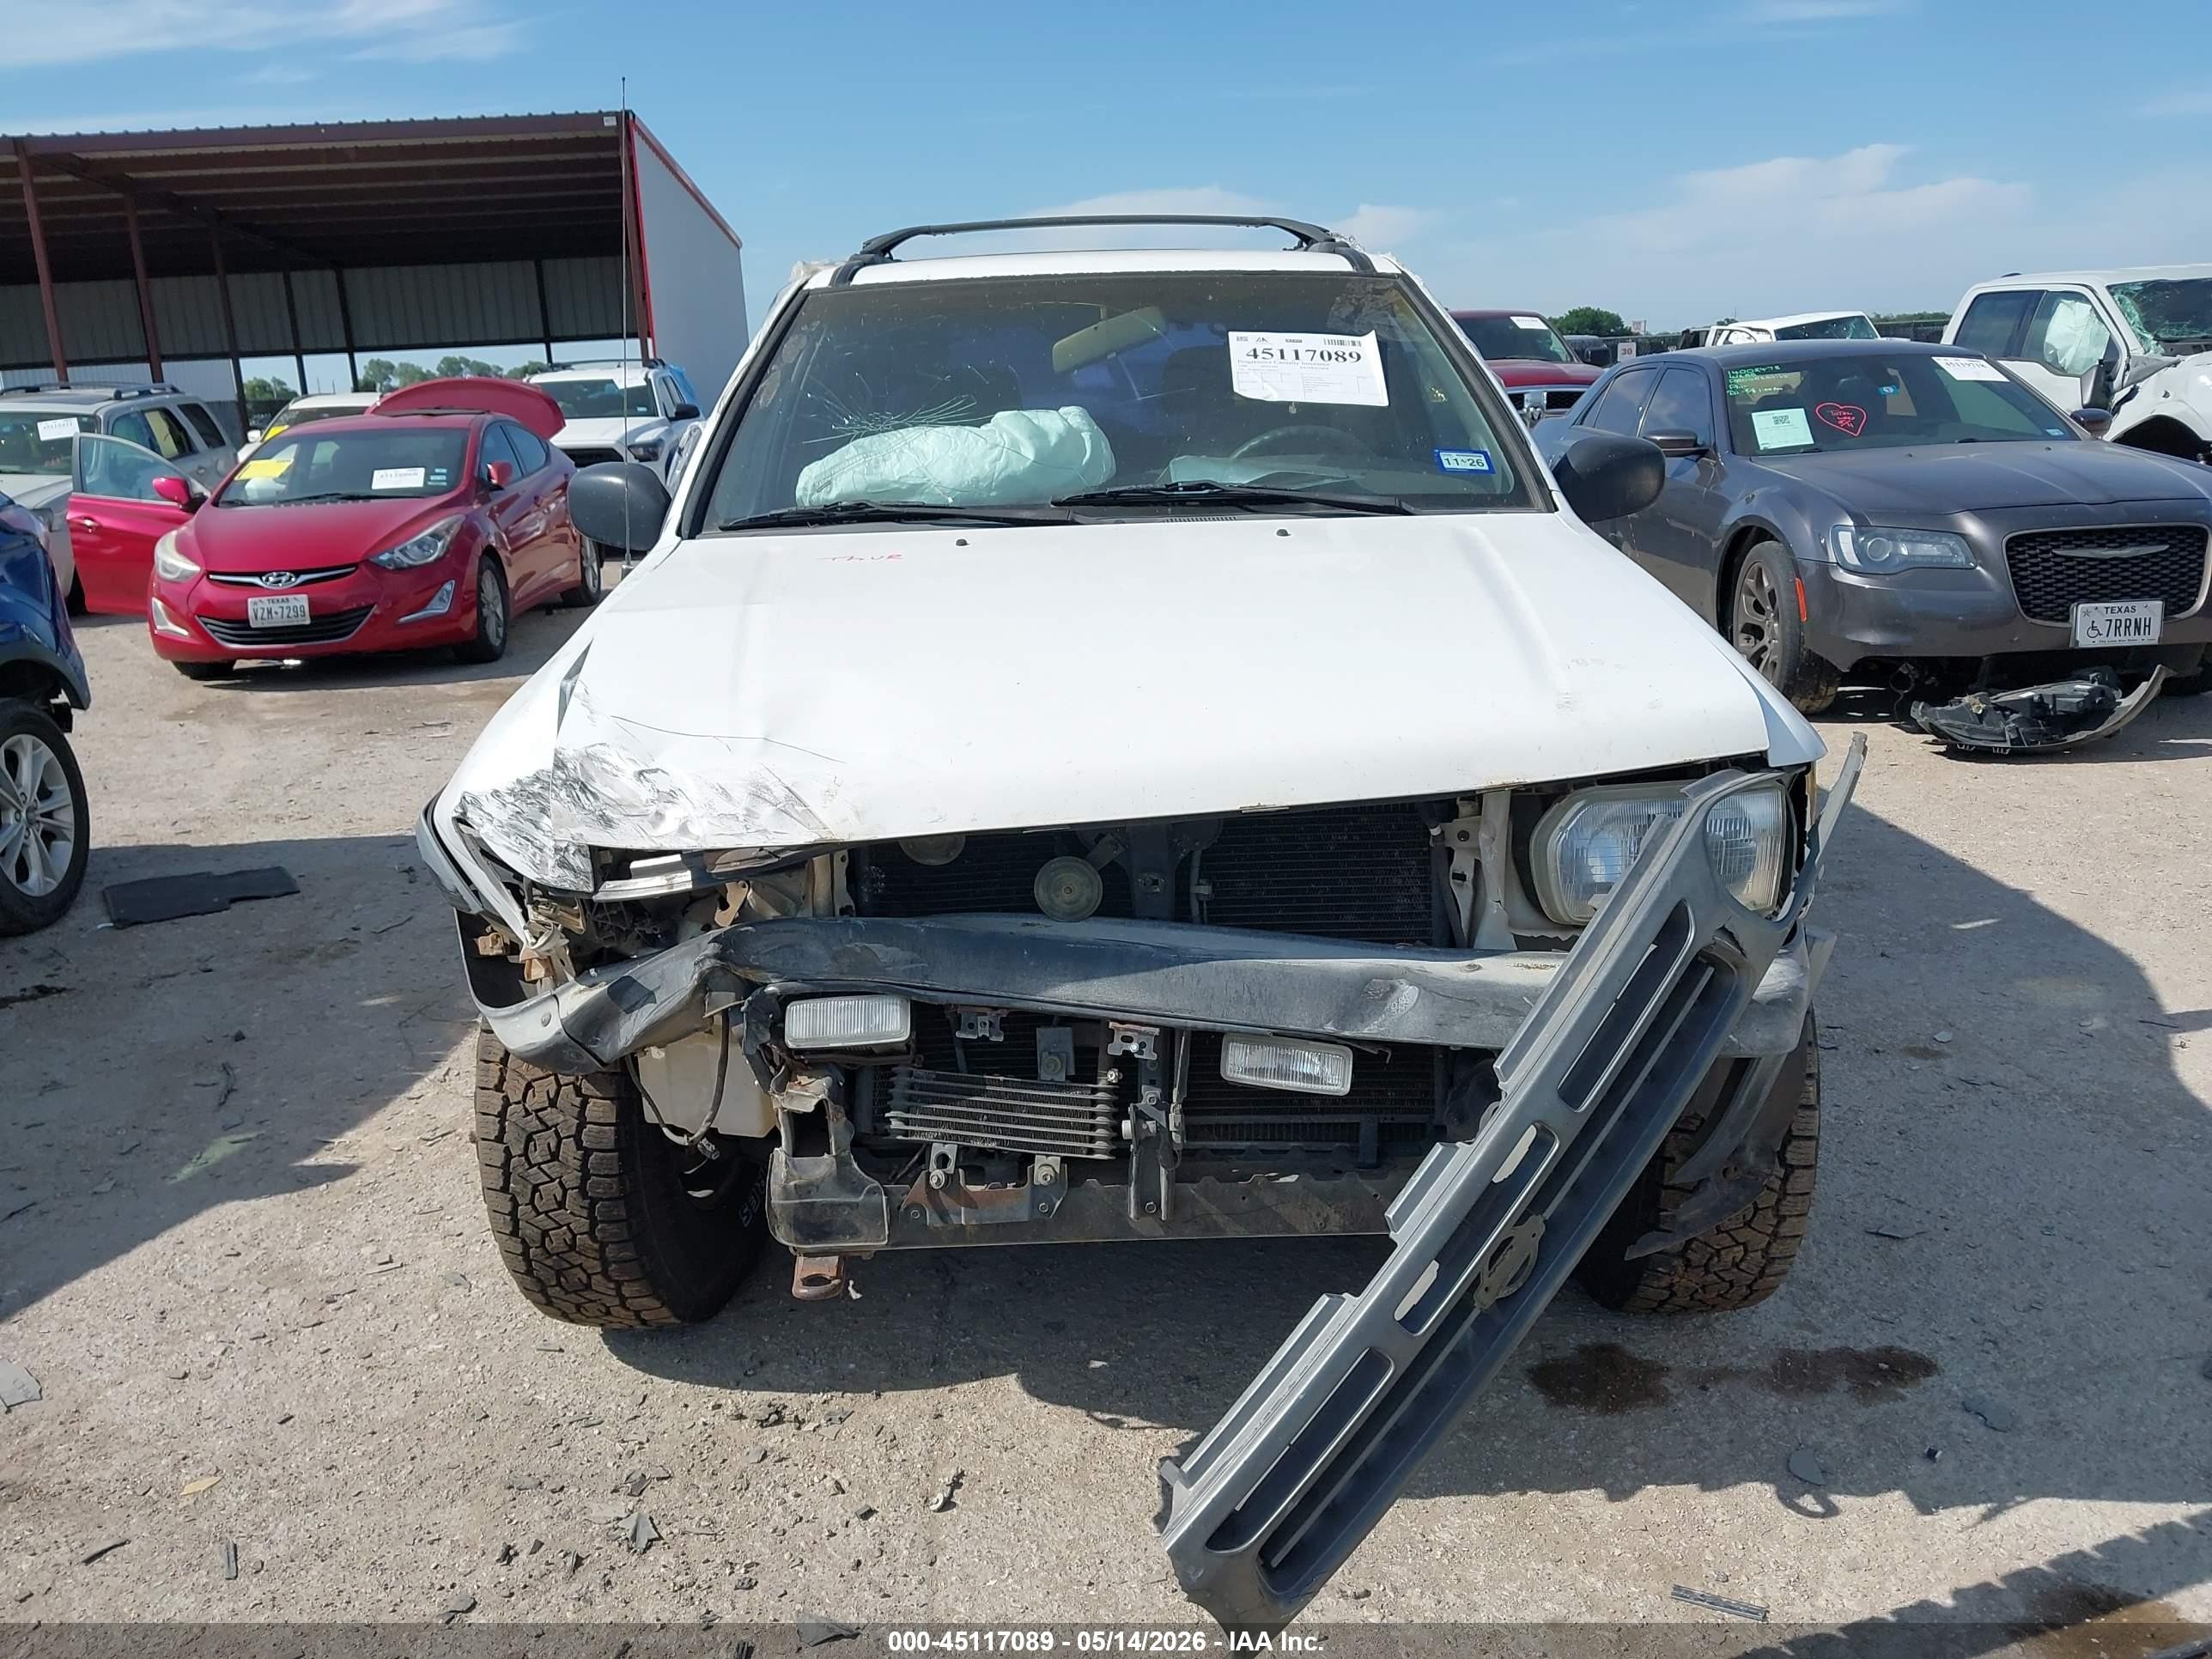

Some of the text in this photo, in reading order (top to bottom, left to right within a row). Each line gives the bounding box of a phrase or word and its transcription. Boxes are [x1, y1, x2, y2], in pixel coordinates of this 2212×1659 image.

[1245, 347, 1362, 363] 45117089
[1443, 458, 1485, 467] 11 26
[2104, 605, 2137, 615] TEXAS
[2105, 617, 2152, 638] 7RRNH
